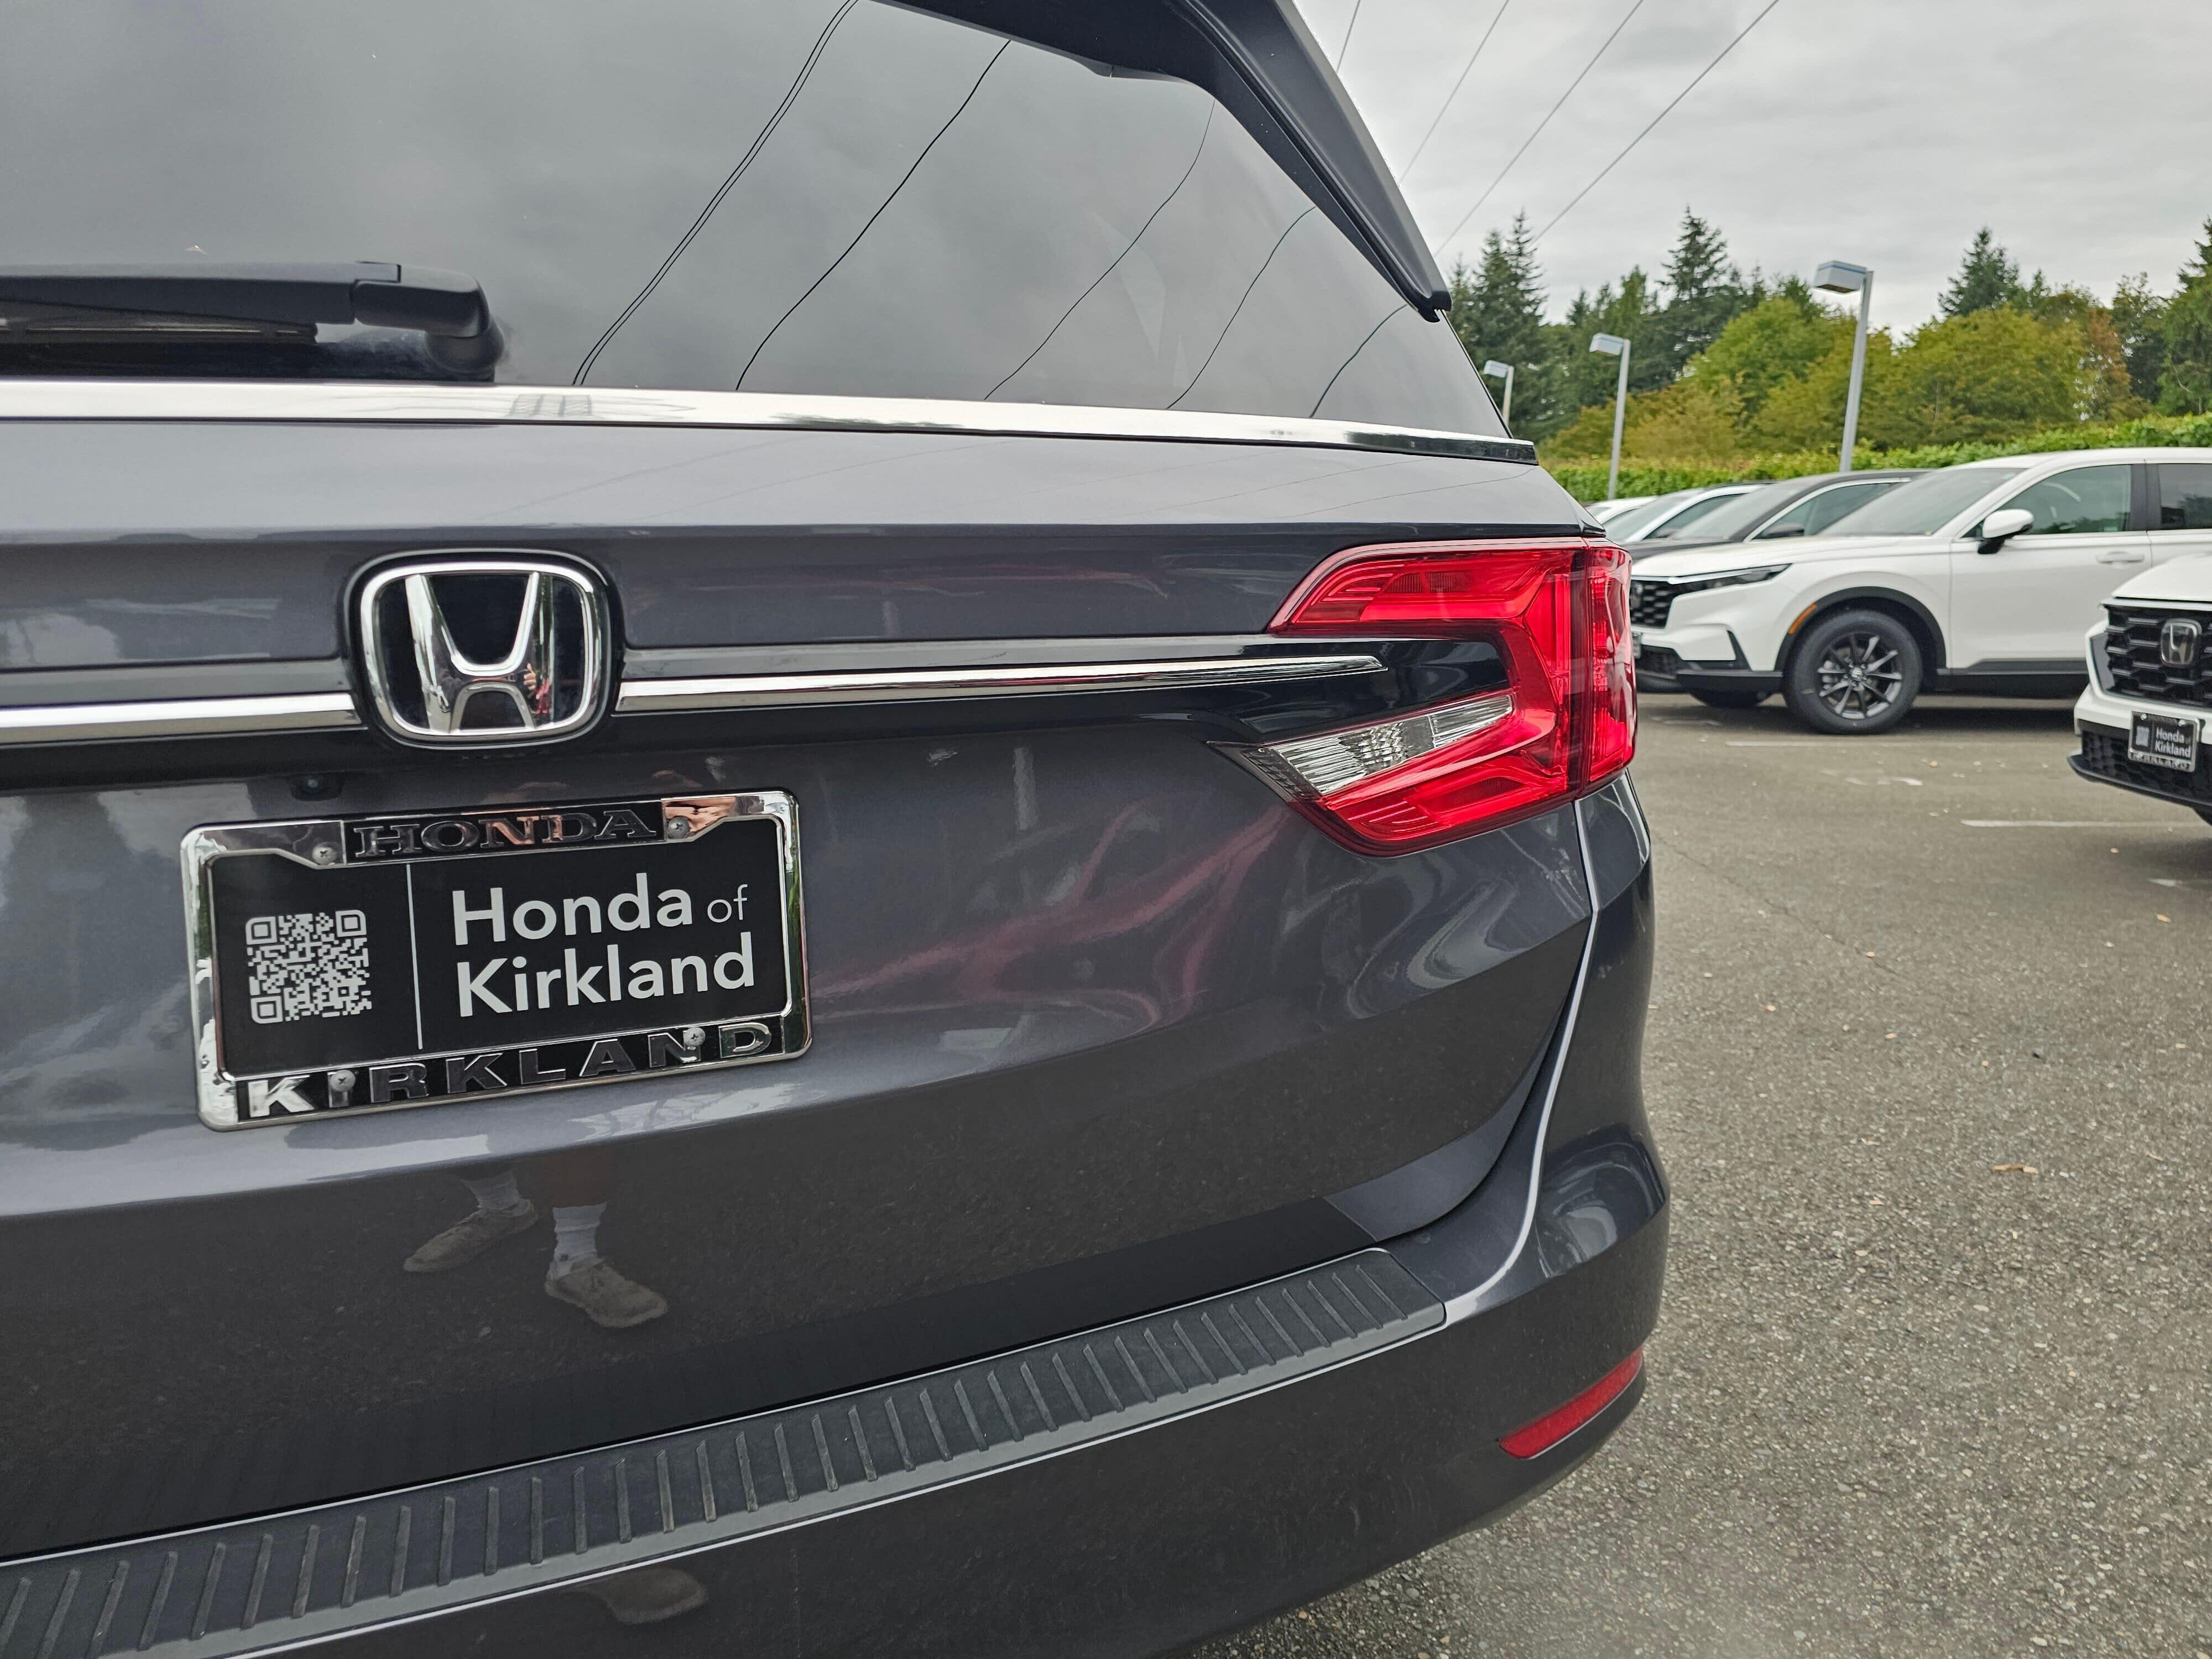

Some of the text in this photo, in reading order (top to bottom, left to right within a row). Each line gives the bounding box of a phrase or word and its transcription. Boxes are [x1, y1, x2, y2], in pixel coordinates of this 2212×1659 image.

[2155, 740, 2191, 758] Kirkland
[353, 809, 657, 858] HONDA
[452, 873, 748, 946] Honda of
[457, 931, 754, 1017] Kirkland
[248, 1022, 773, 1118] KIRKLAND
